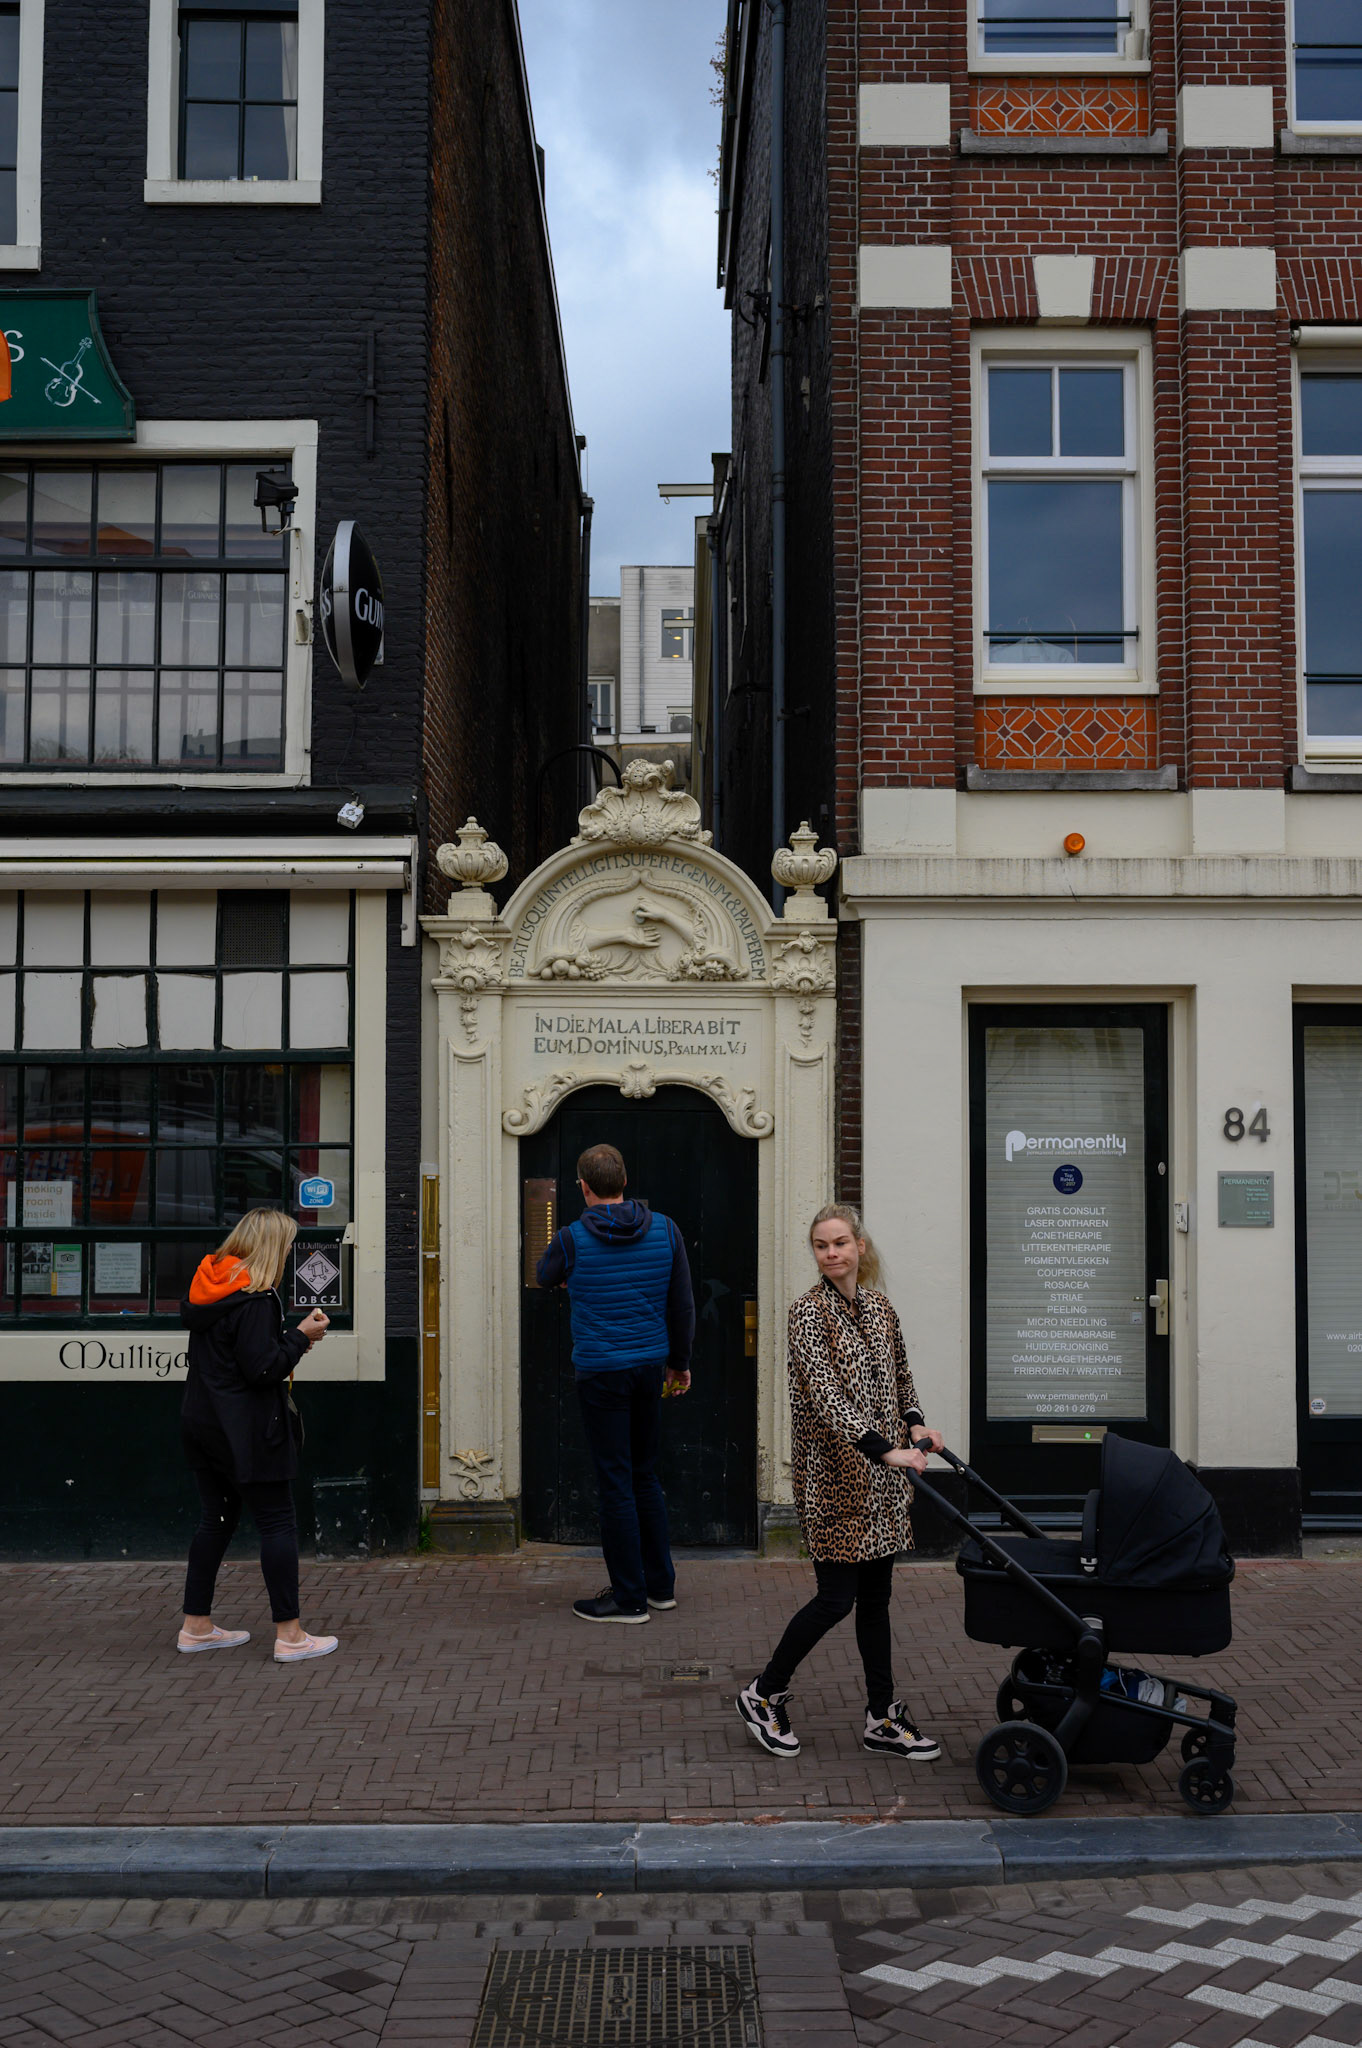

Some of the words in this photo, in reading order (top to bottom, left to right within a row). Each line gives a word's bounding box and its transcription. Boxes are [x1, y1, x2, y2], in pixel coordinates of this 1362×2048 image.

[621, 851, 670, 870] SUPER
[525, 894, 548, 924] QUI
[726, 898, 741, 913] &
[733, 907, 767, 981] PAUPEREM
[508, 920, 535, 978] BEATUS
[1223, 1106, 1271, 1143] 84
[1026, 1206, 1061, 1216] GRATIS
[1062, 1206, 1107, 1216] CONSULT
[1024, 1219, 1055, 1228] LASER
[1056, 1219, 1109, 1228] ONTHAREN
[1030, 1231, 1102, 1240] ACNETHERAPIE
[1021, 1243, 1112, 1252] LITTEKENTHERAPIE
[1024, 1256, 1109, 1265] PIGMENTVLEKKEN
[1036, 1268, 1096, 1278] COUPEROSE
[1044, 1281, 1090, 1289] ROSACEA
[1050, 1293, 1084, 1302] STRIAE
[1047, 1305, 1088, 1314] PEELING
[1026, 1318, 1058, 1327] MICRO
[1060, 1318, 1108, 1327] NEEDLING
[1017, 1330, 1049, 1339] MICRO
[1050, 1330, 1117, 1339] DERMABRASIE
[1025, 1343, 1109, 1351] HUIDVERJONGING
[59, 1340, 190, 1378] Mulliga
[1011, 1355, 1123, 1364] CAMOUFLAGETHERAPIE
[1013, 1367, 1069, 1376] FRIBROMEN
[1076, 1367, 1122, 1376] WRATTEN
[1026, 1392, 1108, 1402] www.permanently.nl
[1036, 1404, 1052, 1413] 020
[1054, 1404, 1070, 1413] 261
[1079, 1404, 1096, 1413] 276
